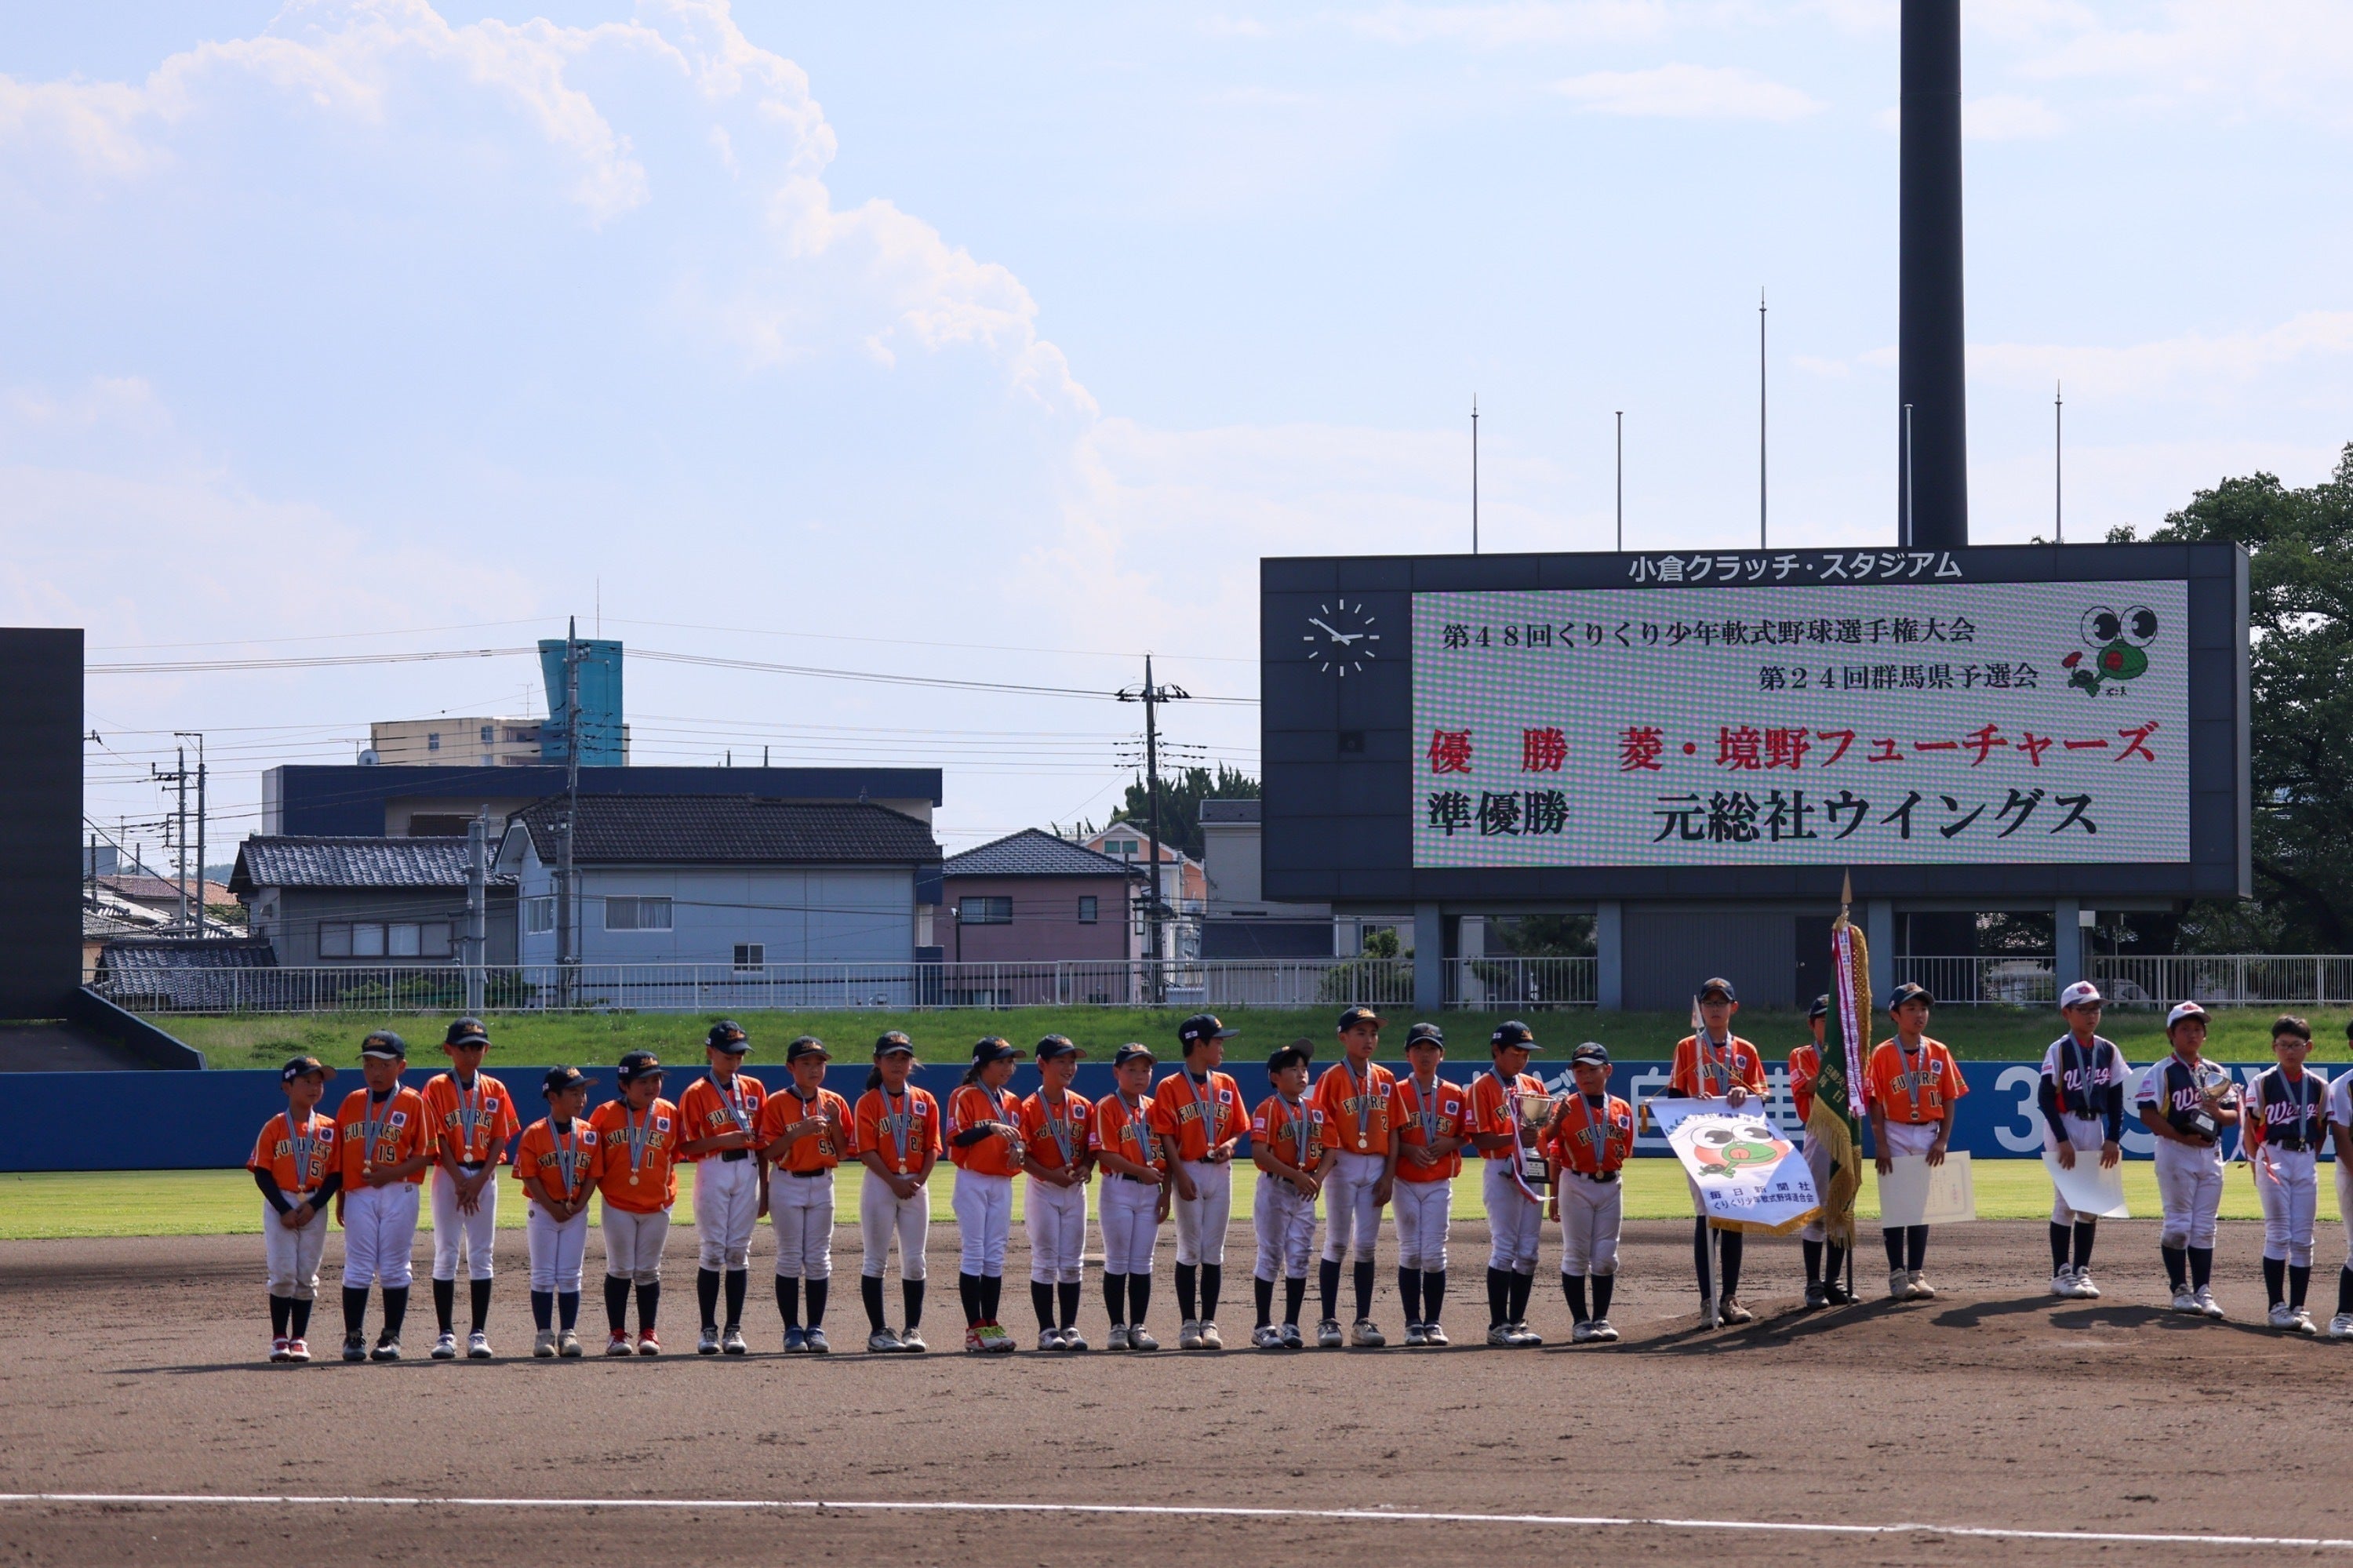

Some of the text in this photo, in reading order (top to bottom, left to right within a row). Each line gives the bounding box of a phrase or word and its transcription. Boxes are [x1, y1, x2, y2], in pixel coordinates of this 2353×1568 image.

[1628, 551, 1962, 583] 小倉クラッチ・スタジアム
[1759, 662, 2039, 691] 第24回群馬県予選会
[1618, 720, 2160, 773] 菱・境野フューチャーズ
[1427, 788, 2097, 843] 準優勝 元総社ウイングス
[1216, 1122, 1226, 1137] 7
[377, 1144, 396, 1163] 19
[646, 1151, 654, 1168] 1
